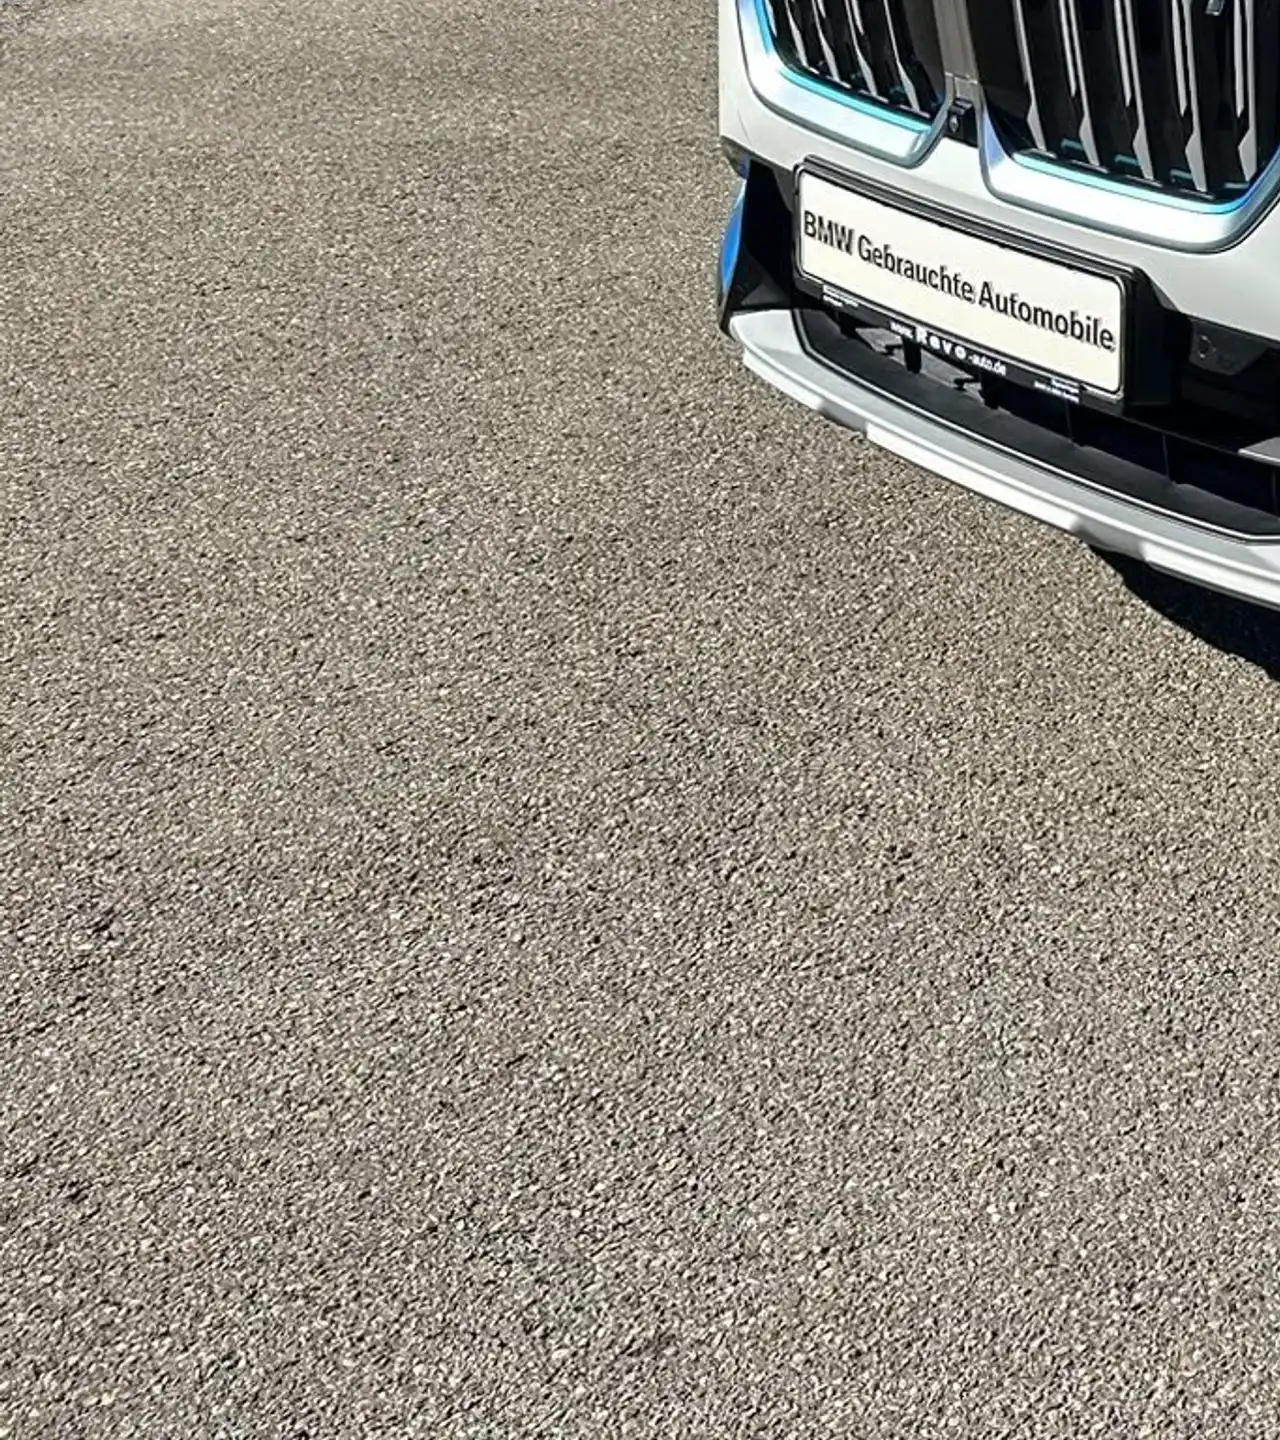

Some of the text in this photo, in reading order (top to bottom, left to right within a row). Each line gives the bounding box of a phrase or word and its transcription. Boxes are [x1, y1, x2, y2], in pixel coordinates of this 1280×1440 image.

[804, 210, 1116, 352] BMW Gebrauchte Automobile
